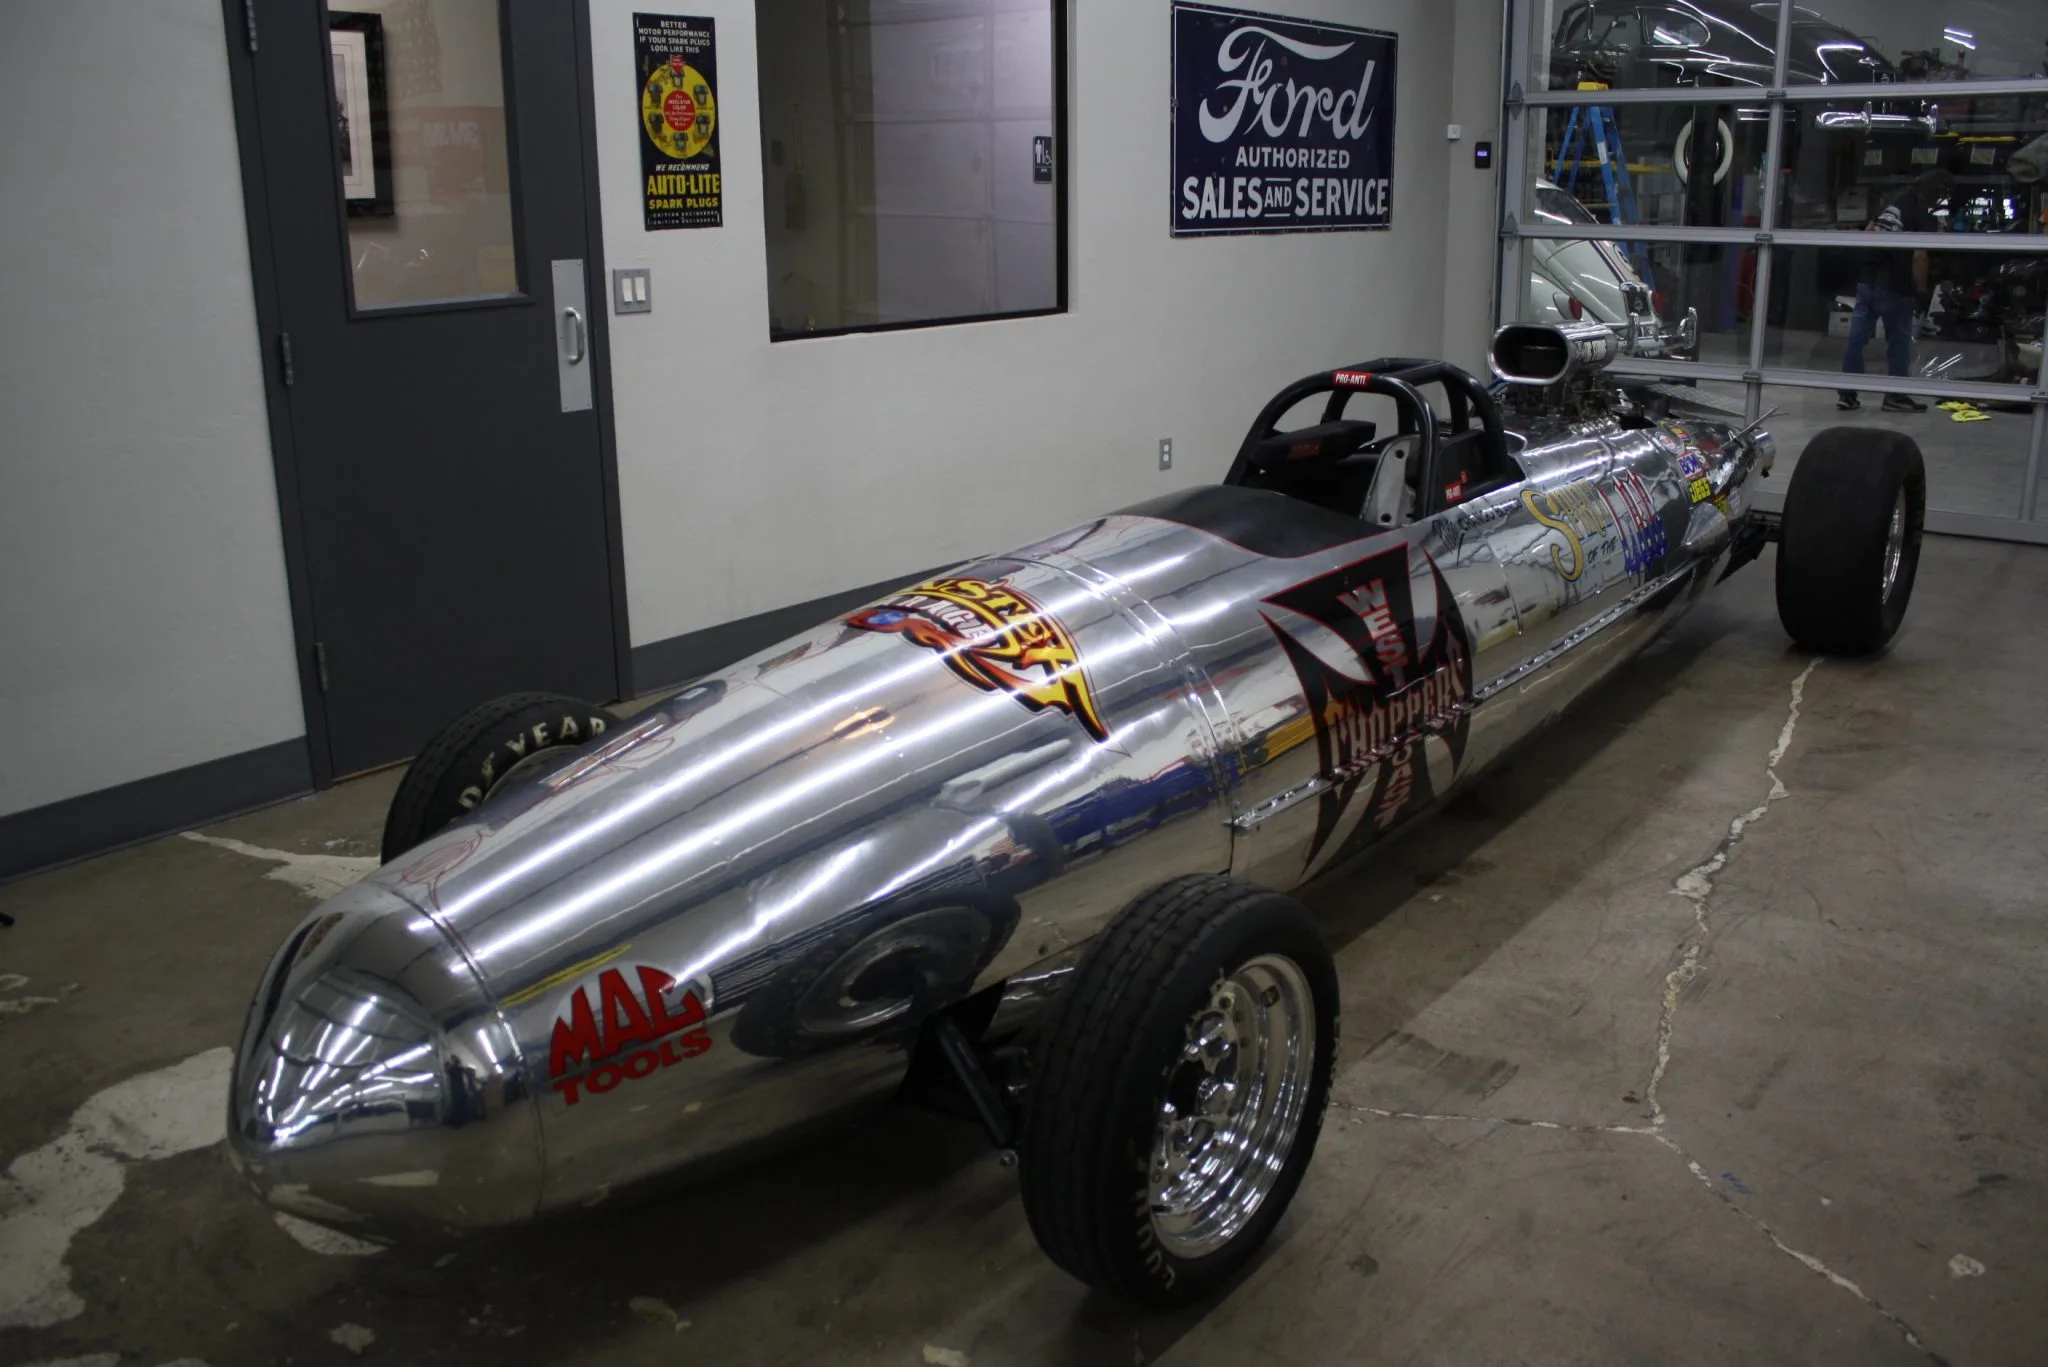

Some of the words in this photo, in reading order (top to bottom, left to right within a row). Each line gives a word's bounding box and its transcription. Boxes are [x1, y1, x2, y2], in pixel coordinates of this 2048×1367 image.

[638, 27, 662, 35] MOTOR
[663, 28, 711, 38] PERFORMANCE
[660, 20, 688, 29] BETTER
[640, 35, 647, 43] IF
[648, 36, 667, 44] YOUR
[668, 37, 689, 45] SPARK
[690, 38, 711, 47] PLUGS
[651, 44, 669, 52] LOOK
[670, 45, 684, 53] LIKE
[1199, 26, 1376, 143] Ford
[1235, 146, 1350, 169] AUTHORIZED
[655, 164, 667, 172] WE
[668, 163, 710, 171] RECOMMEND
[649, 198, 683, 210] SPARK
[686, 197, 718, 209] PLUGS
[1182, 176, 1262, 219] SALES
[1264, 186, 1292, 208] AND
[1295, 177, 1389, 217] SERVICE
[1335, 373, 1367, 386] PRO-ANTI
[1587, 545, 1600, 565] OF
[1601, 536, 1617, 557] THE
[1336, 578, 1409, 692] WEST
[549, 964, 707, 1079] MAC
[553, 1026, 713, 1106] TOOLS
